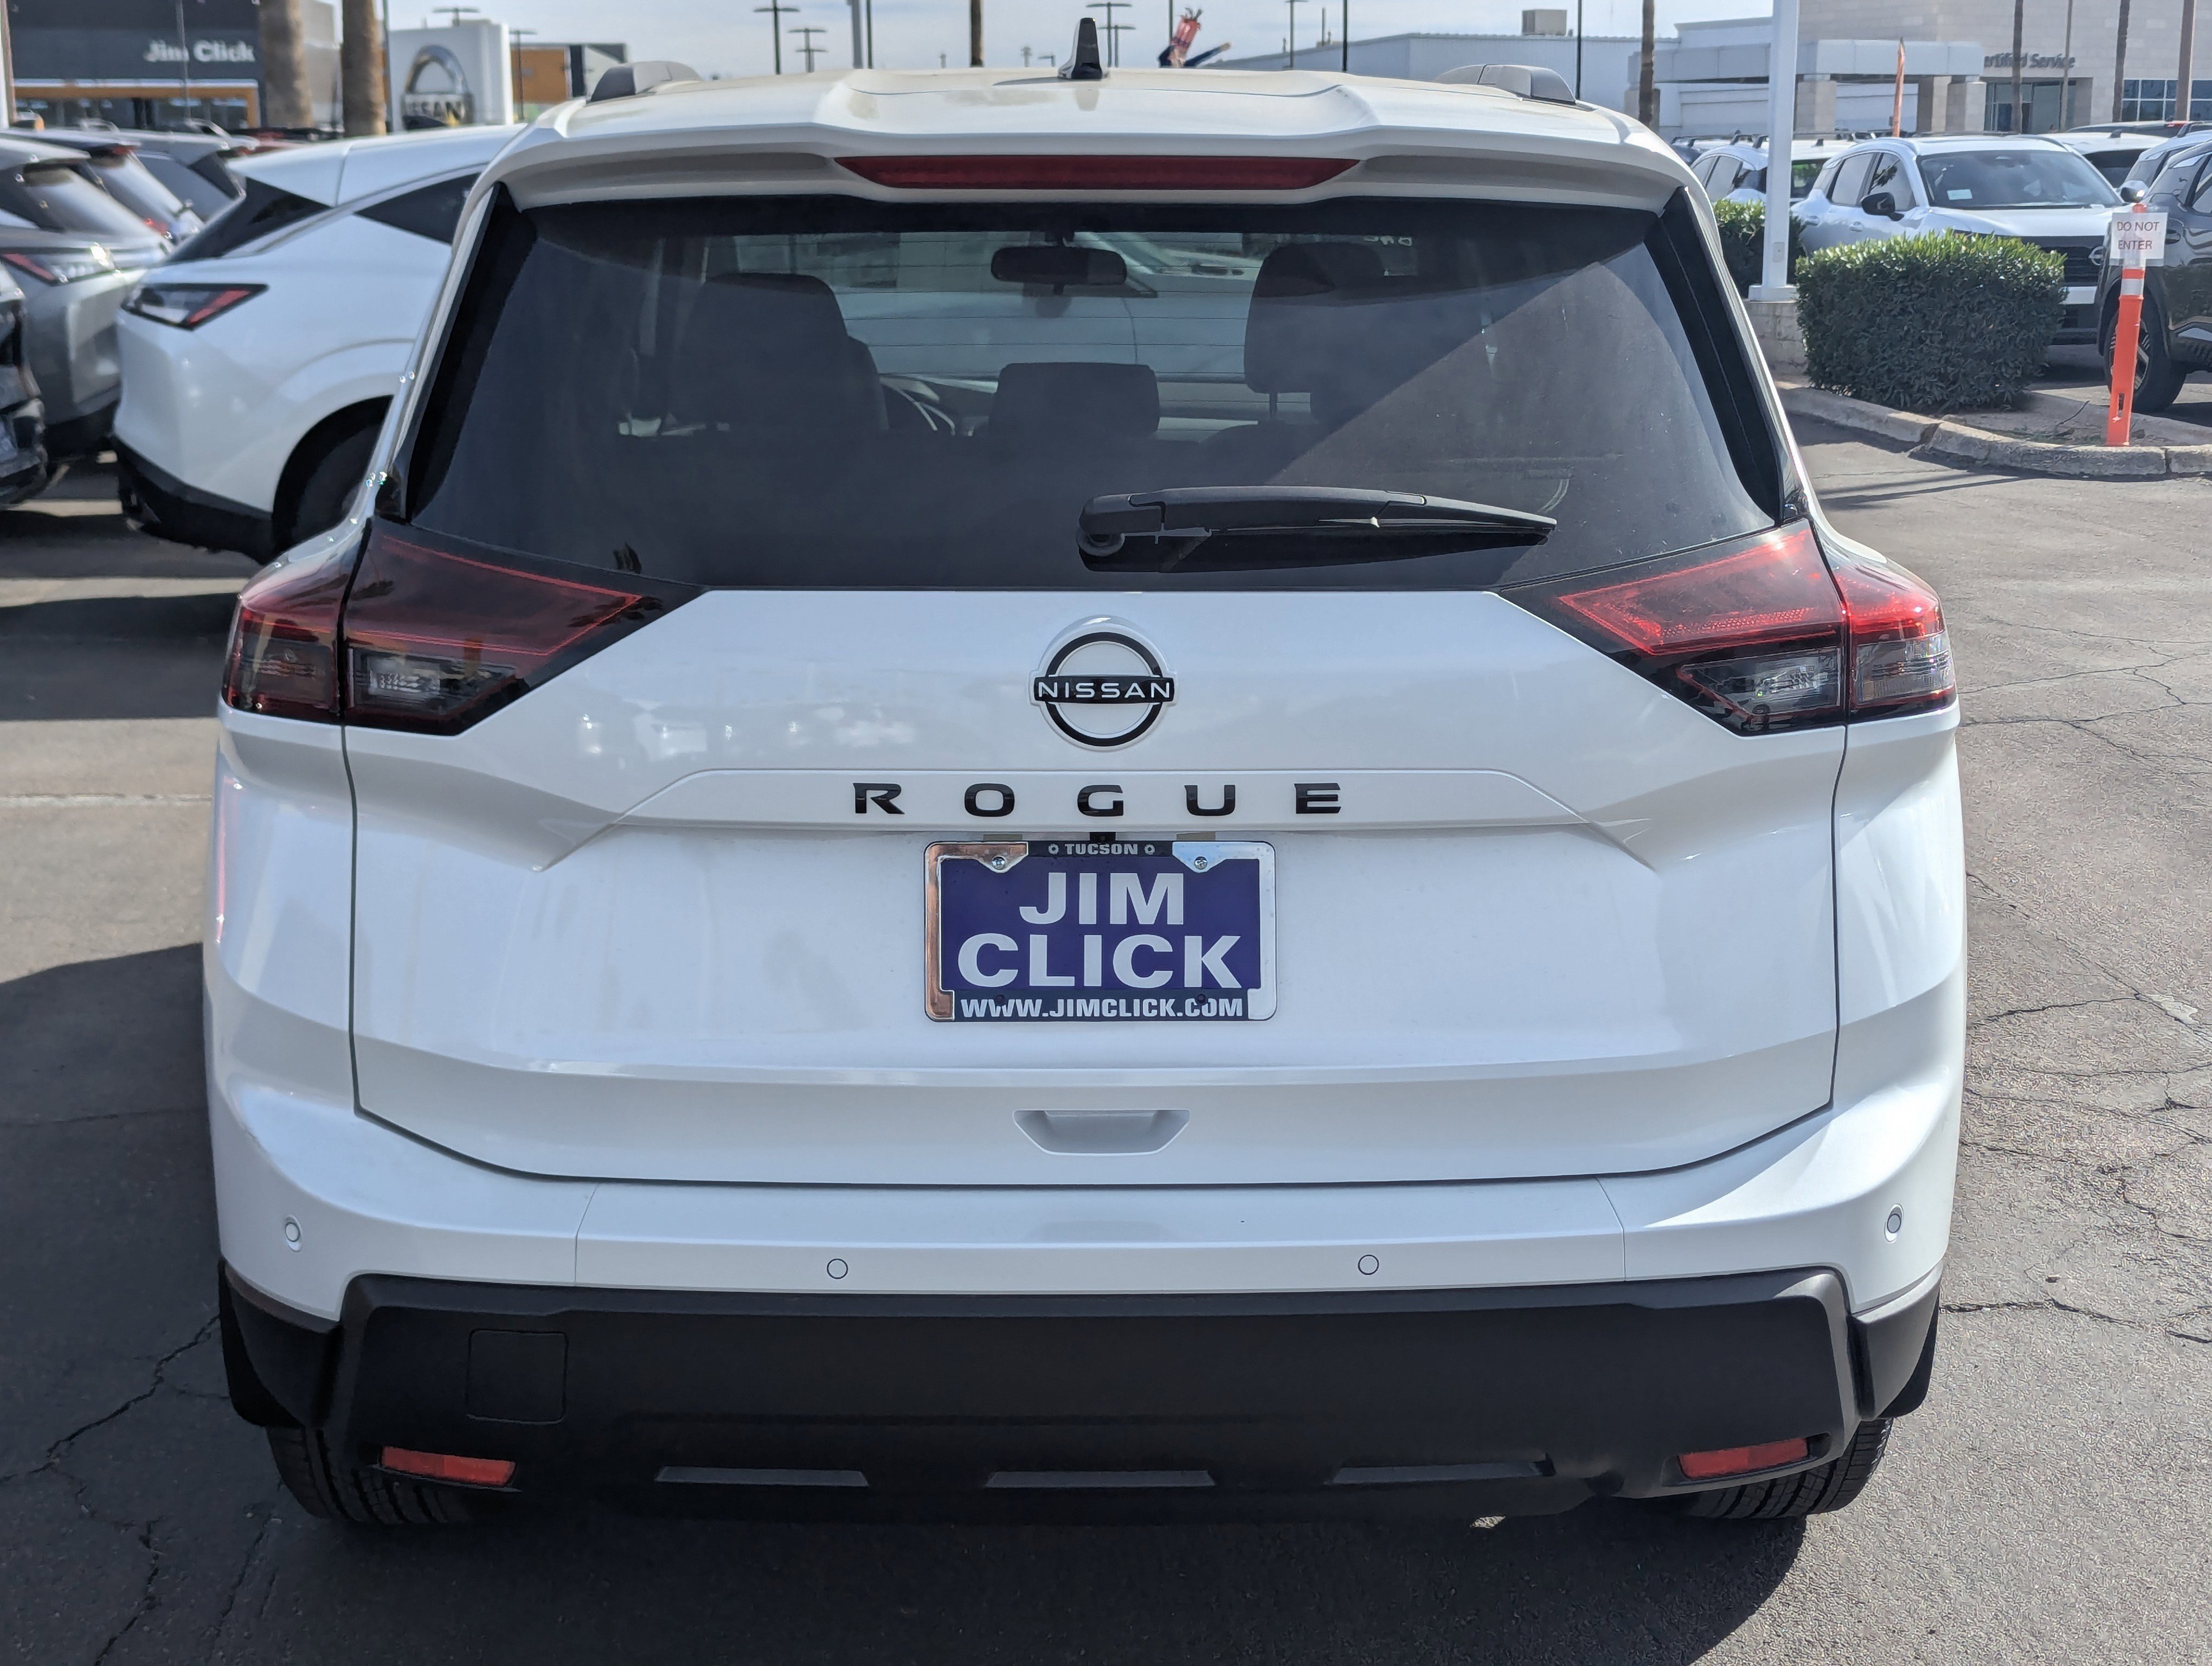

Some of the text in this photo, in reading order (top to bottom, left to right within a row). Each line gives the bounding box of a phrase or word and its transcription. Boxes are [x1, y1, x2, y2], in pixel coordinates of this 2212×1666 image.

[143, 40, 255, 63] Jim Click
[2117, 221, 2159, 231] DO NOT
[2118, 240, 2152, 250] ENTER
[1038, 682, 1171, 698] NISSAN
[853, 783, 1341, 817] ROGUE
[1065, 843, 1138, 855] TUCSON
[1019, 873, 1185, 925] JIM
[957, 933, 1243, 988] CLICK
[961, 998, 1243, 1017] WWW.JIMCLICK.COM
